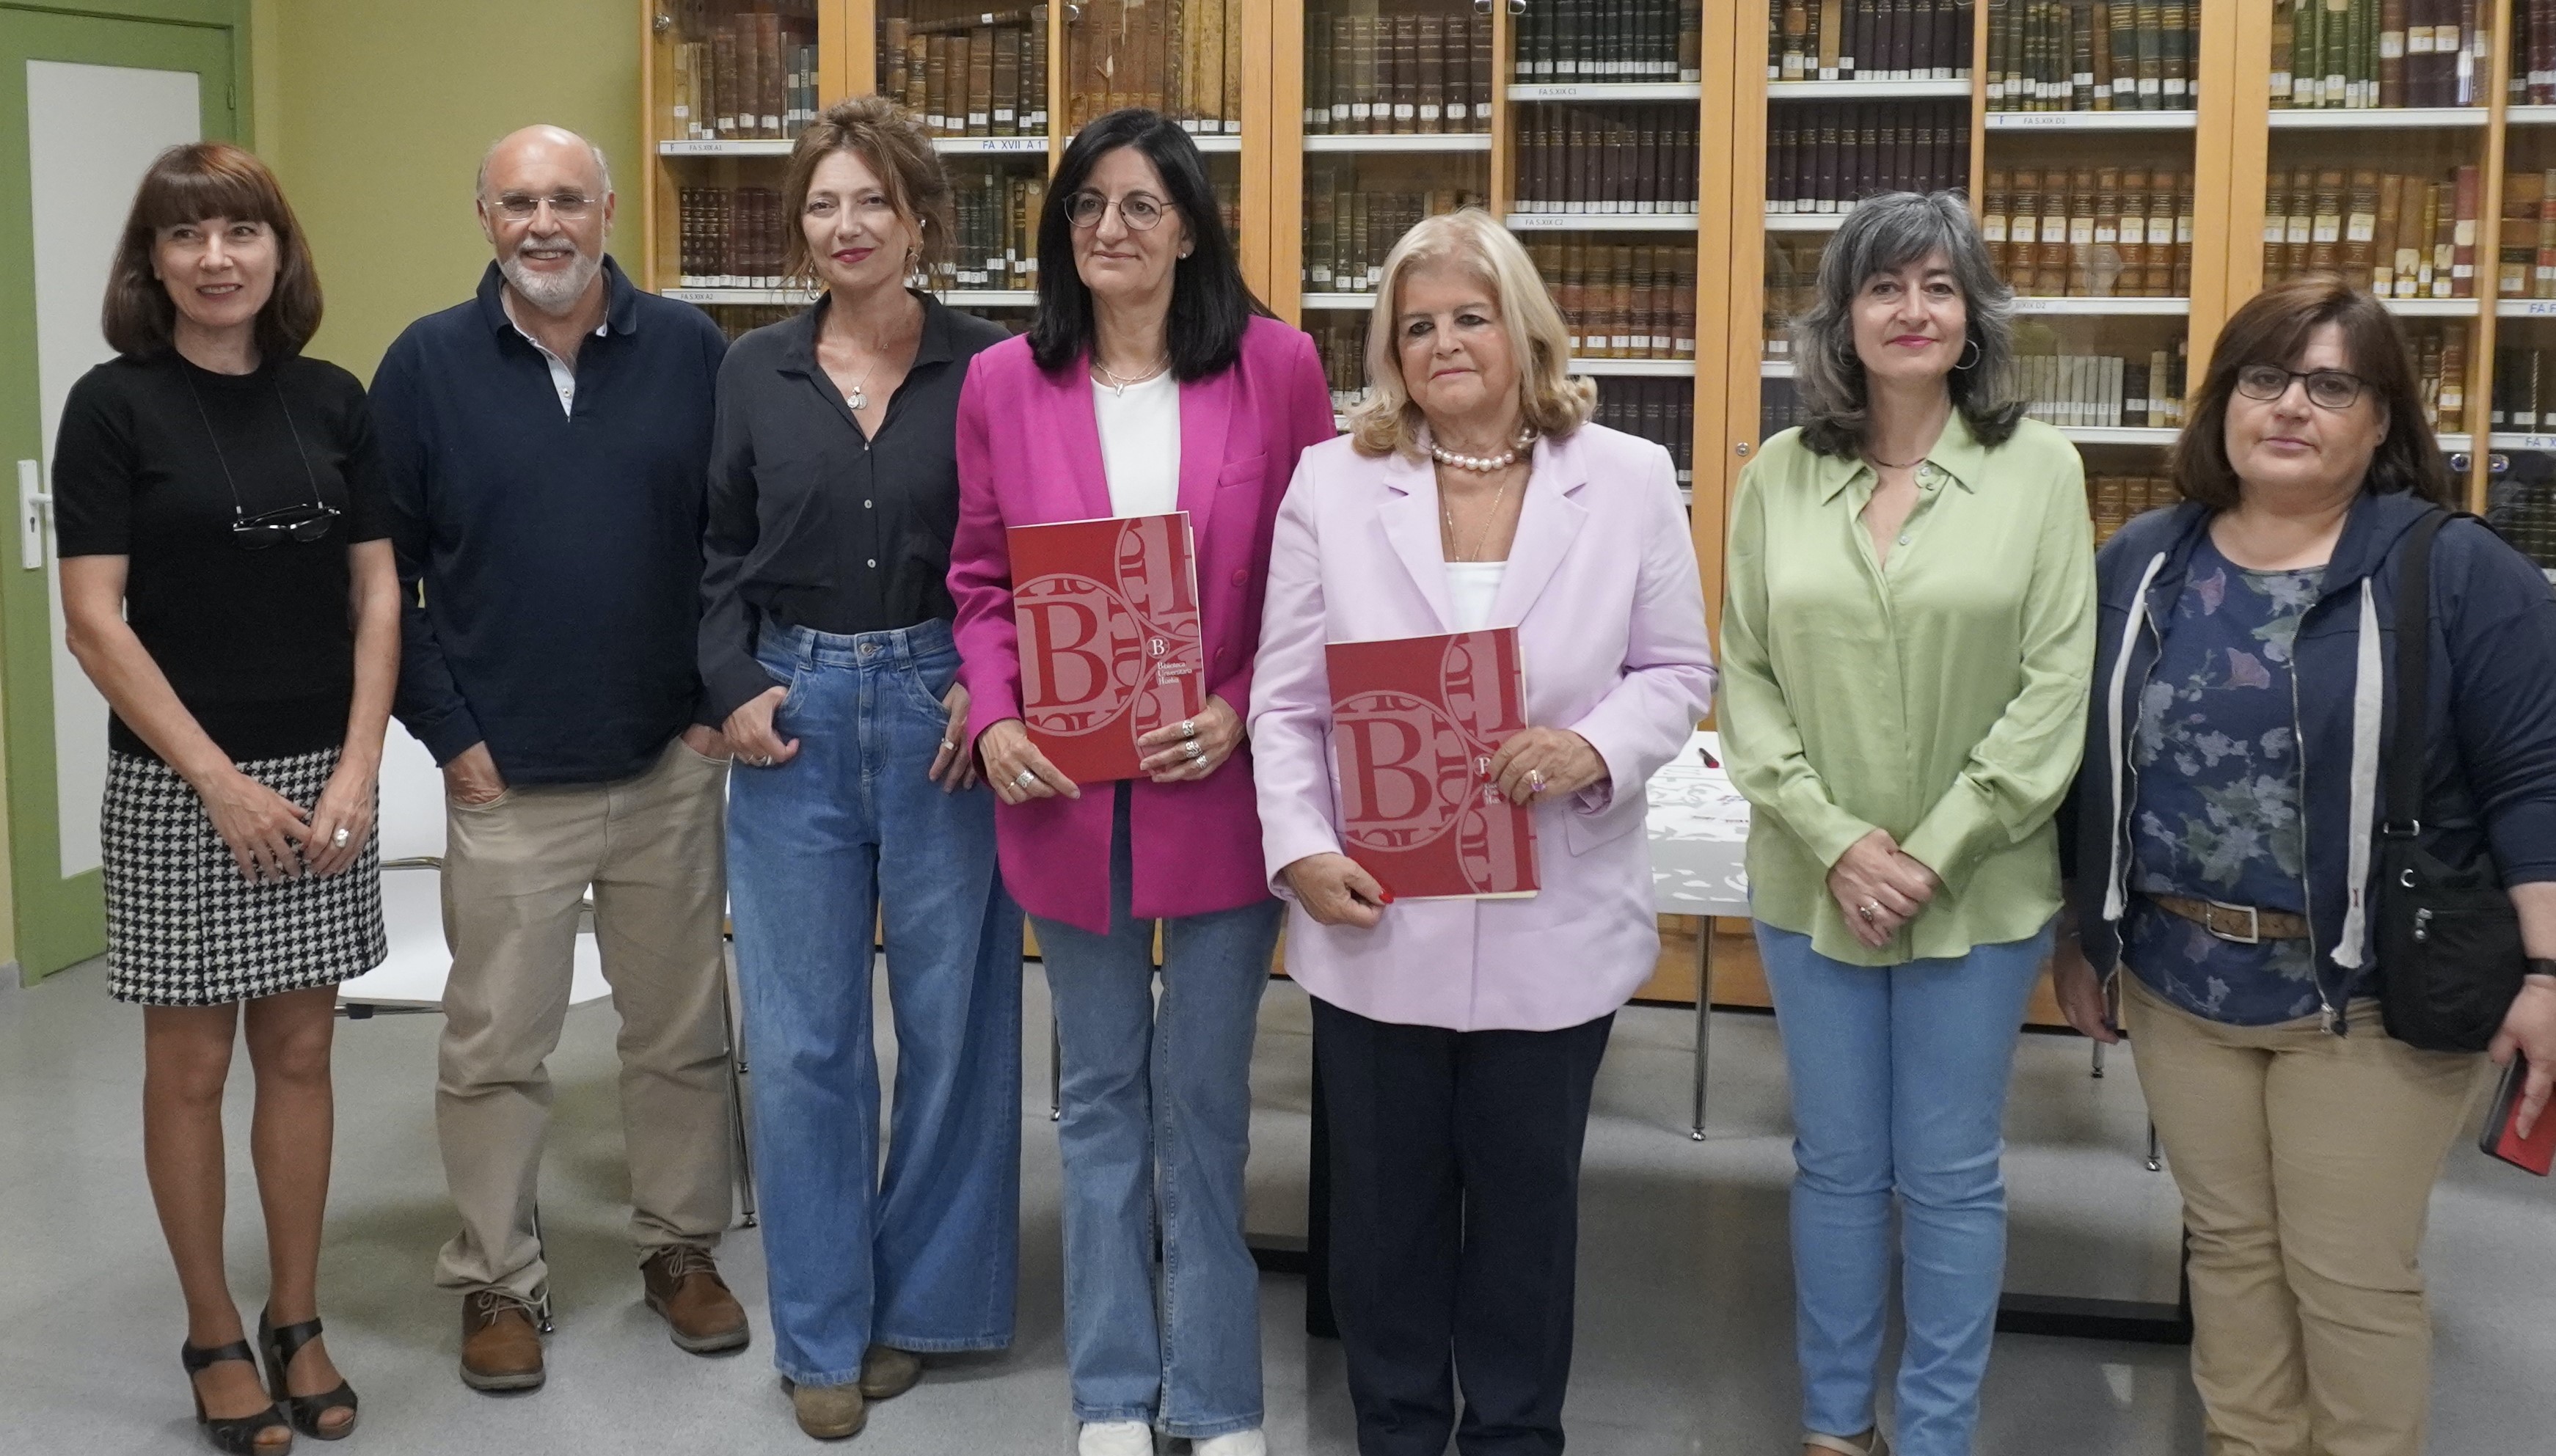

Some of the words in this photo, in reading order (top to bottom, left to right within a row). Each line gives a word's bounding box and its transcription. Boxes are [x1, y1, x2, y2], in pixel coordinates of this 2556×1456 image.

[982, 140, 996, 150] FA
[1001, 140, 1020, 150] XVII
[1026, 140, 1034, 150] A
[2530, 303, 2545, 313] FA
[2525, 436, 2541, 447] FA
[1151, 638, 1165, 656] B
[1017, 601, 1109, 709] B
[1336, 717, 1433, 823] B
